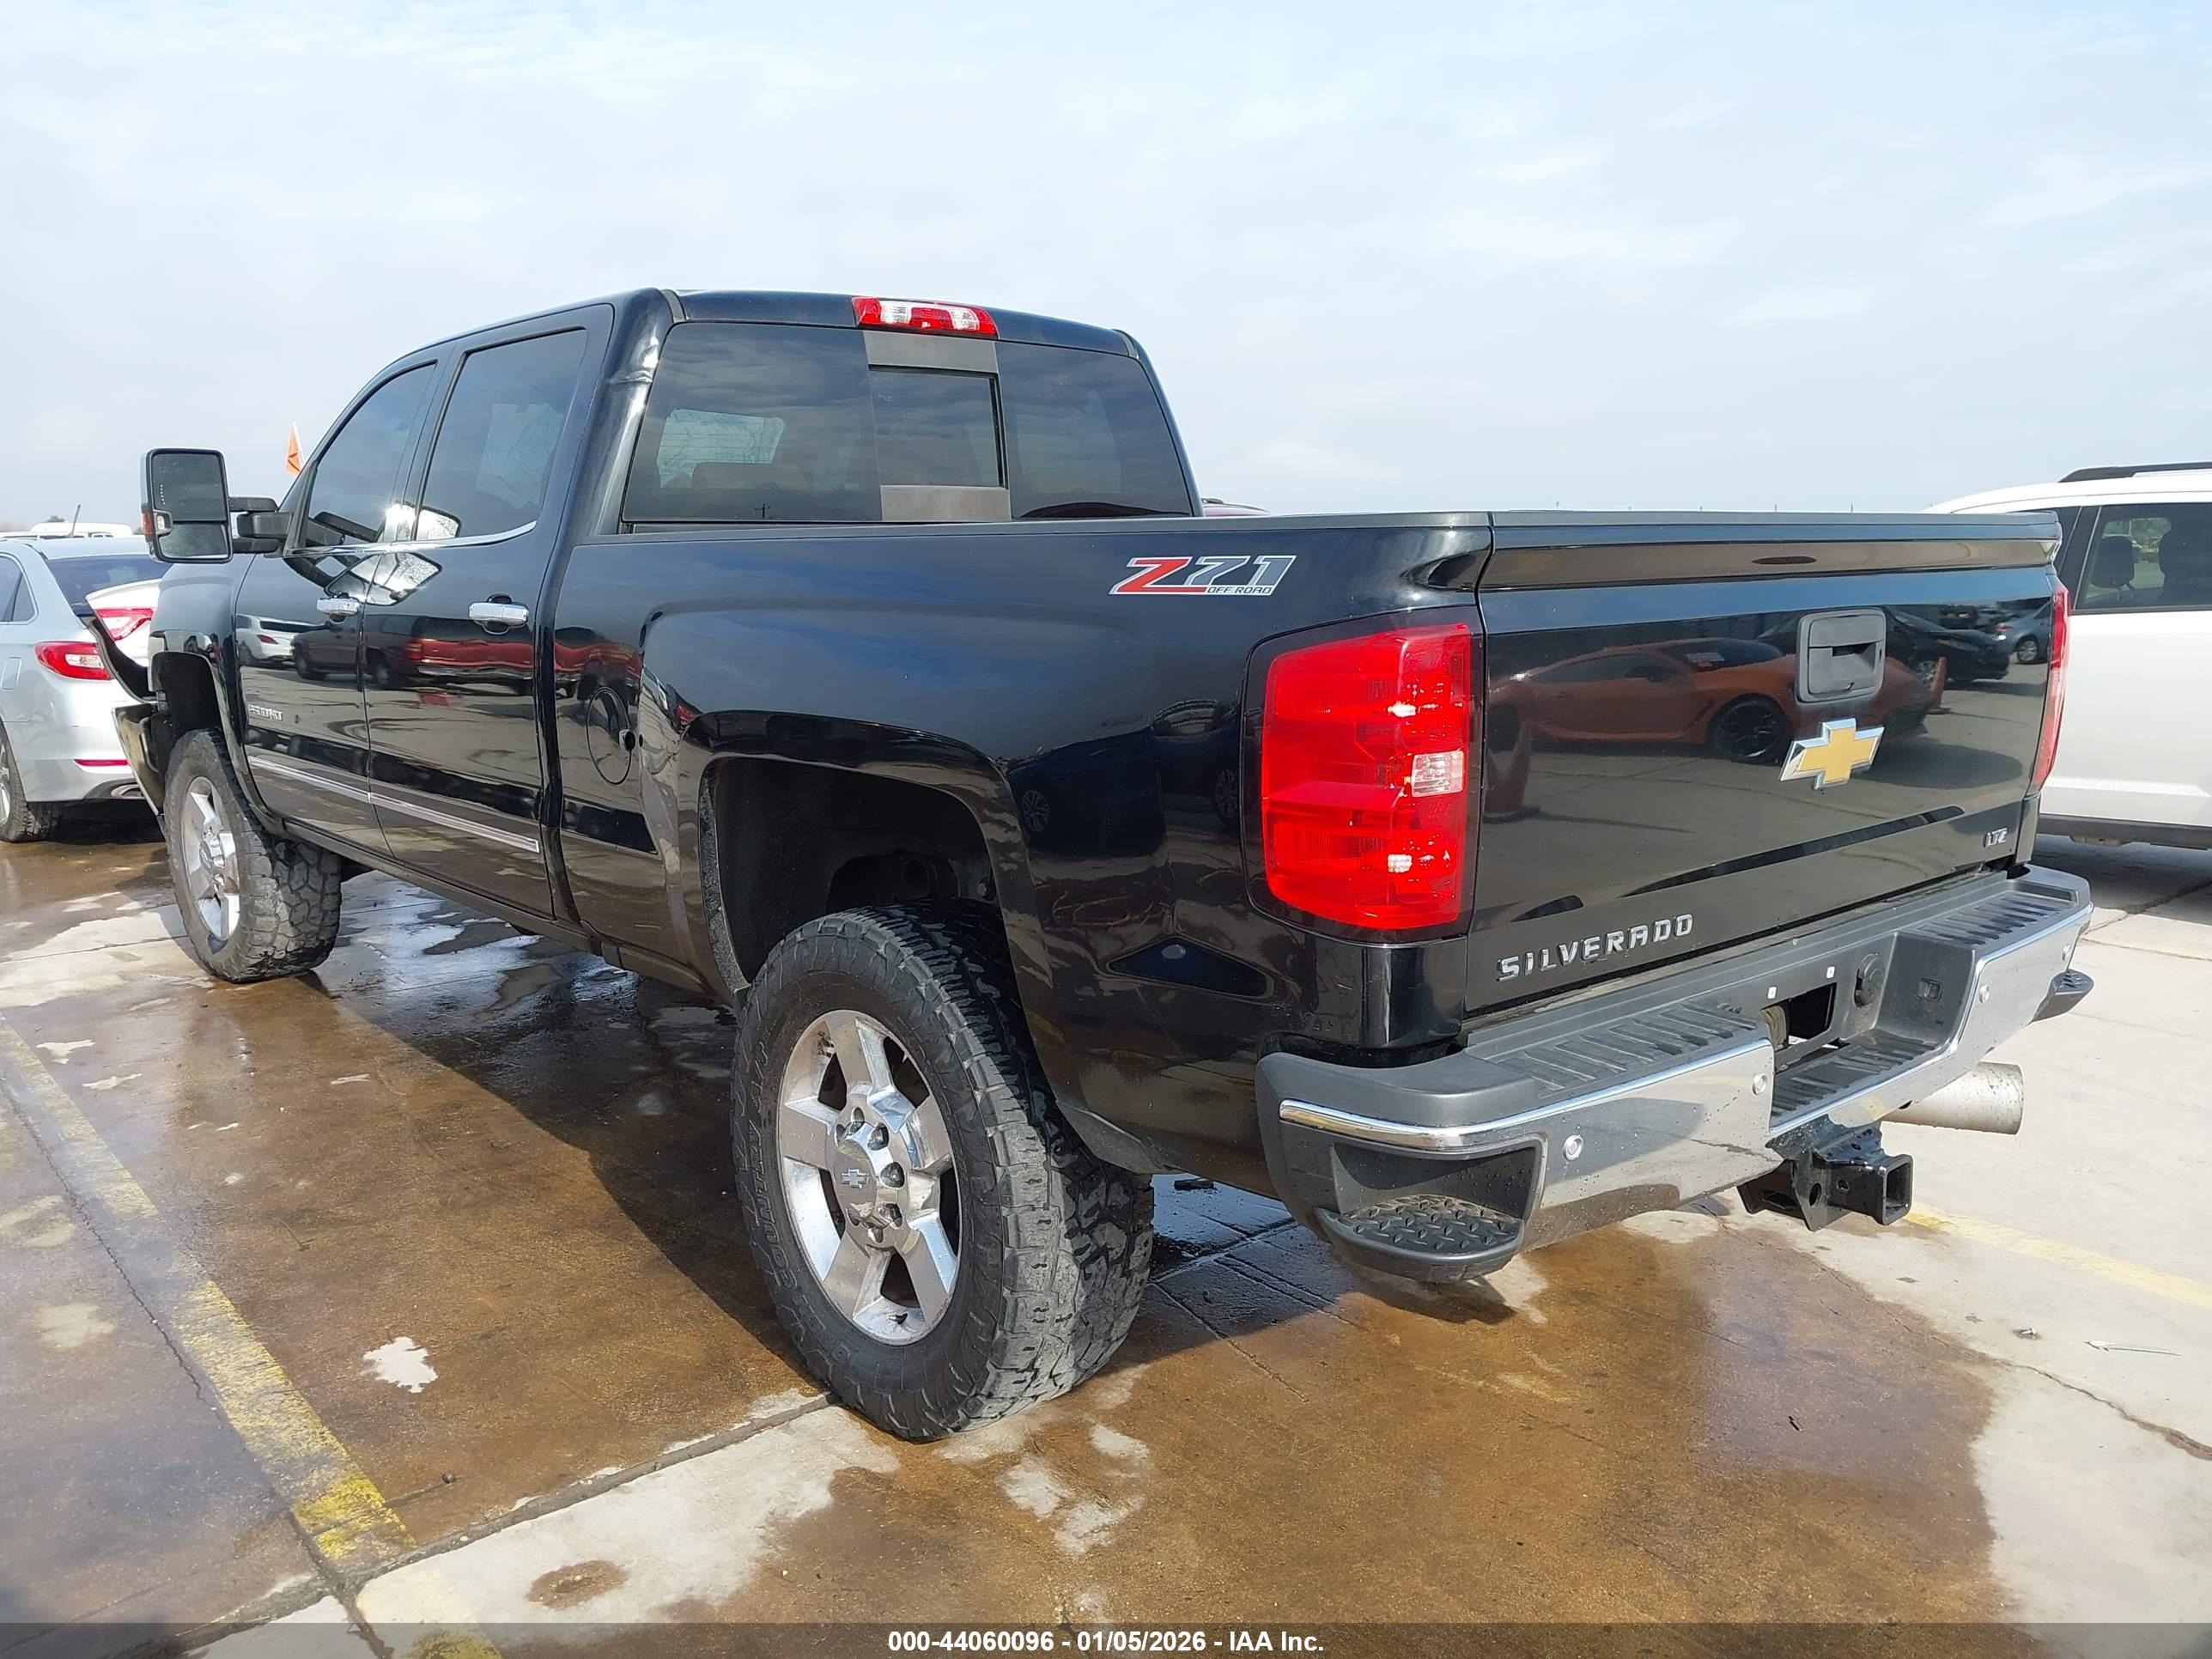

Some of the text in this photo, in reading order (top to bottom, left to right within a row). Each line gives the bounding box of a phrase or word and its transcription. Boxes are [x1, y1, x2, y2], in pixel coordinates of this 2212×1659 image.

[1109, 555, 1297, 595] Z71
[1984, 827, 2008, 848] LTZ
[1497, 914, 1693, 982] SILVERADO
